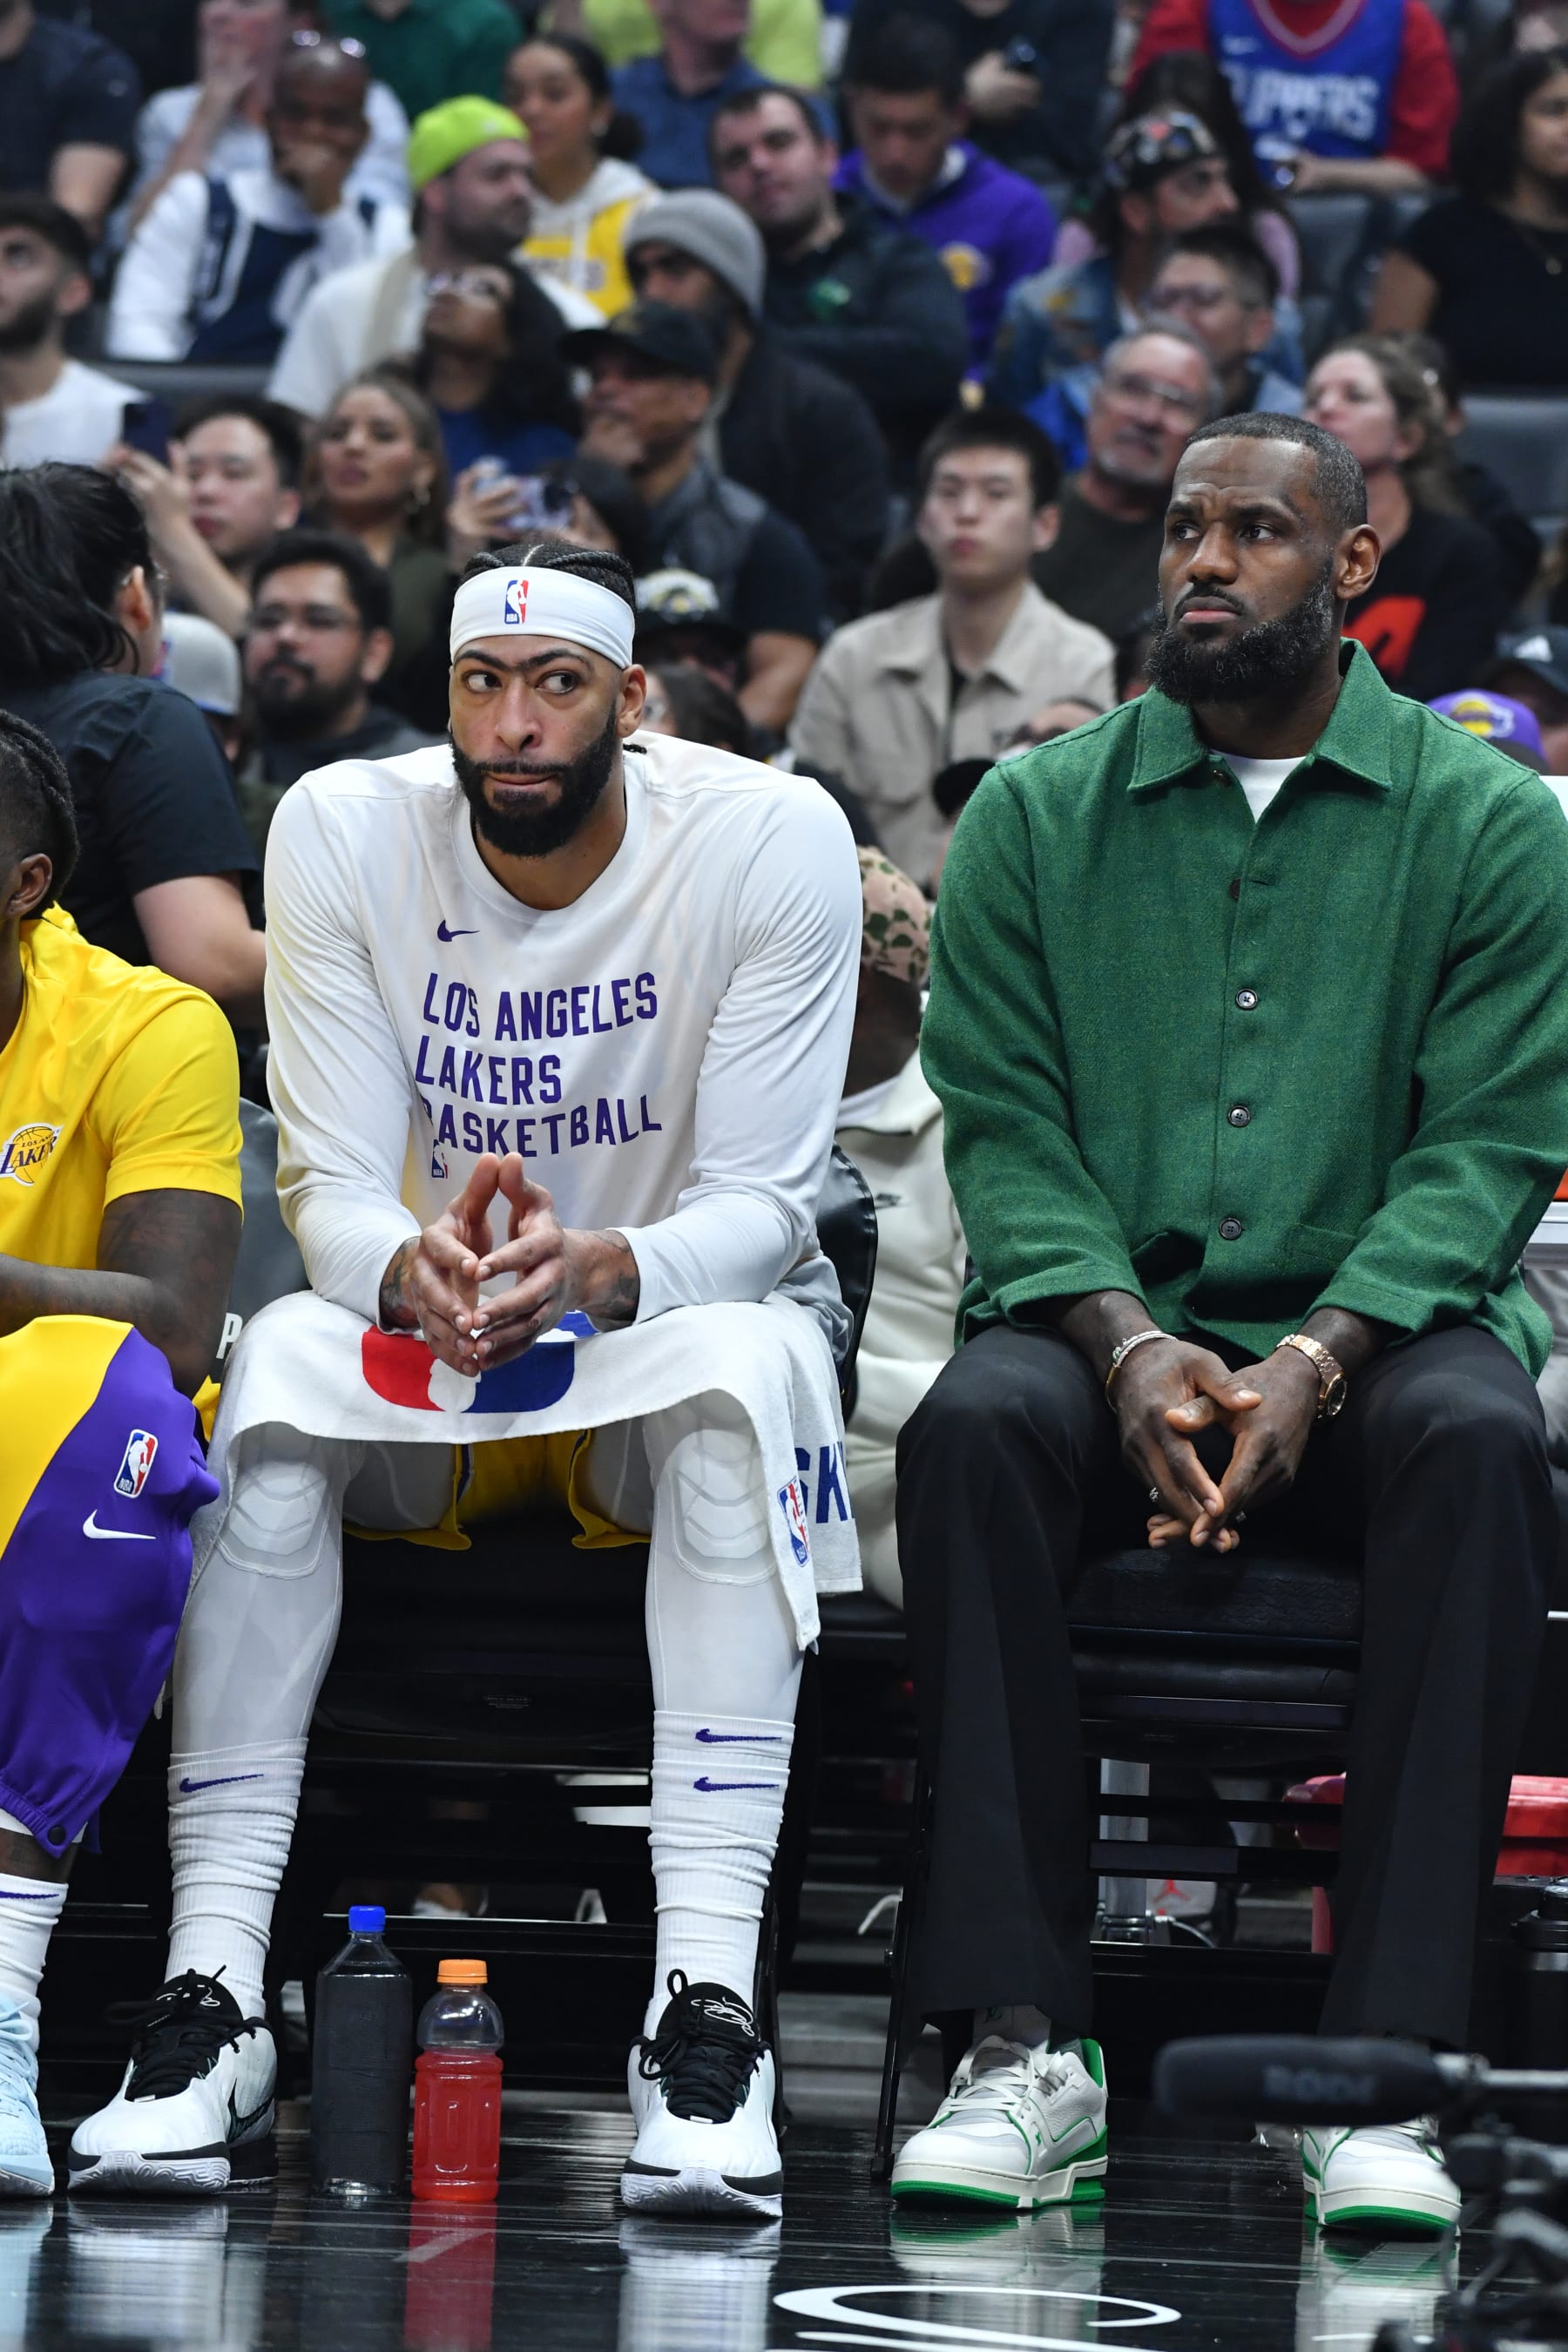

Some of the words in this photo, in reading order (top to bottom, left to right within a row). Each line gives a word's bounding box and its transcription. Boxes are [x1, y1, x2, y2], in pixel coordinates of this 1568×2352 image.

[423, 972, 480, 1037] LOS
[494, 971, 658, 1041] ANGELES
[415, 1035, 562, 1105] LAKERS
